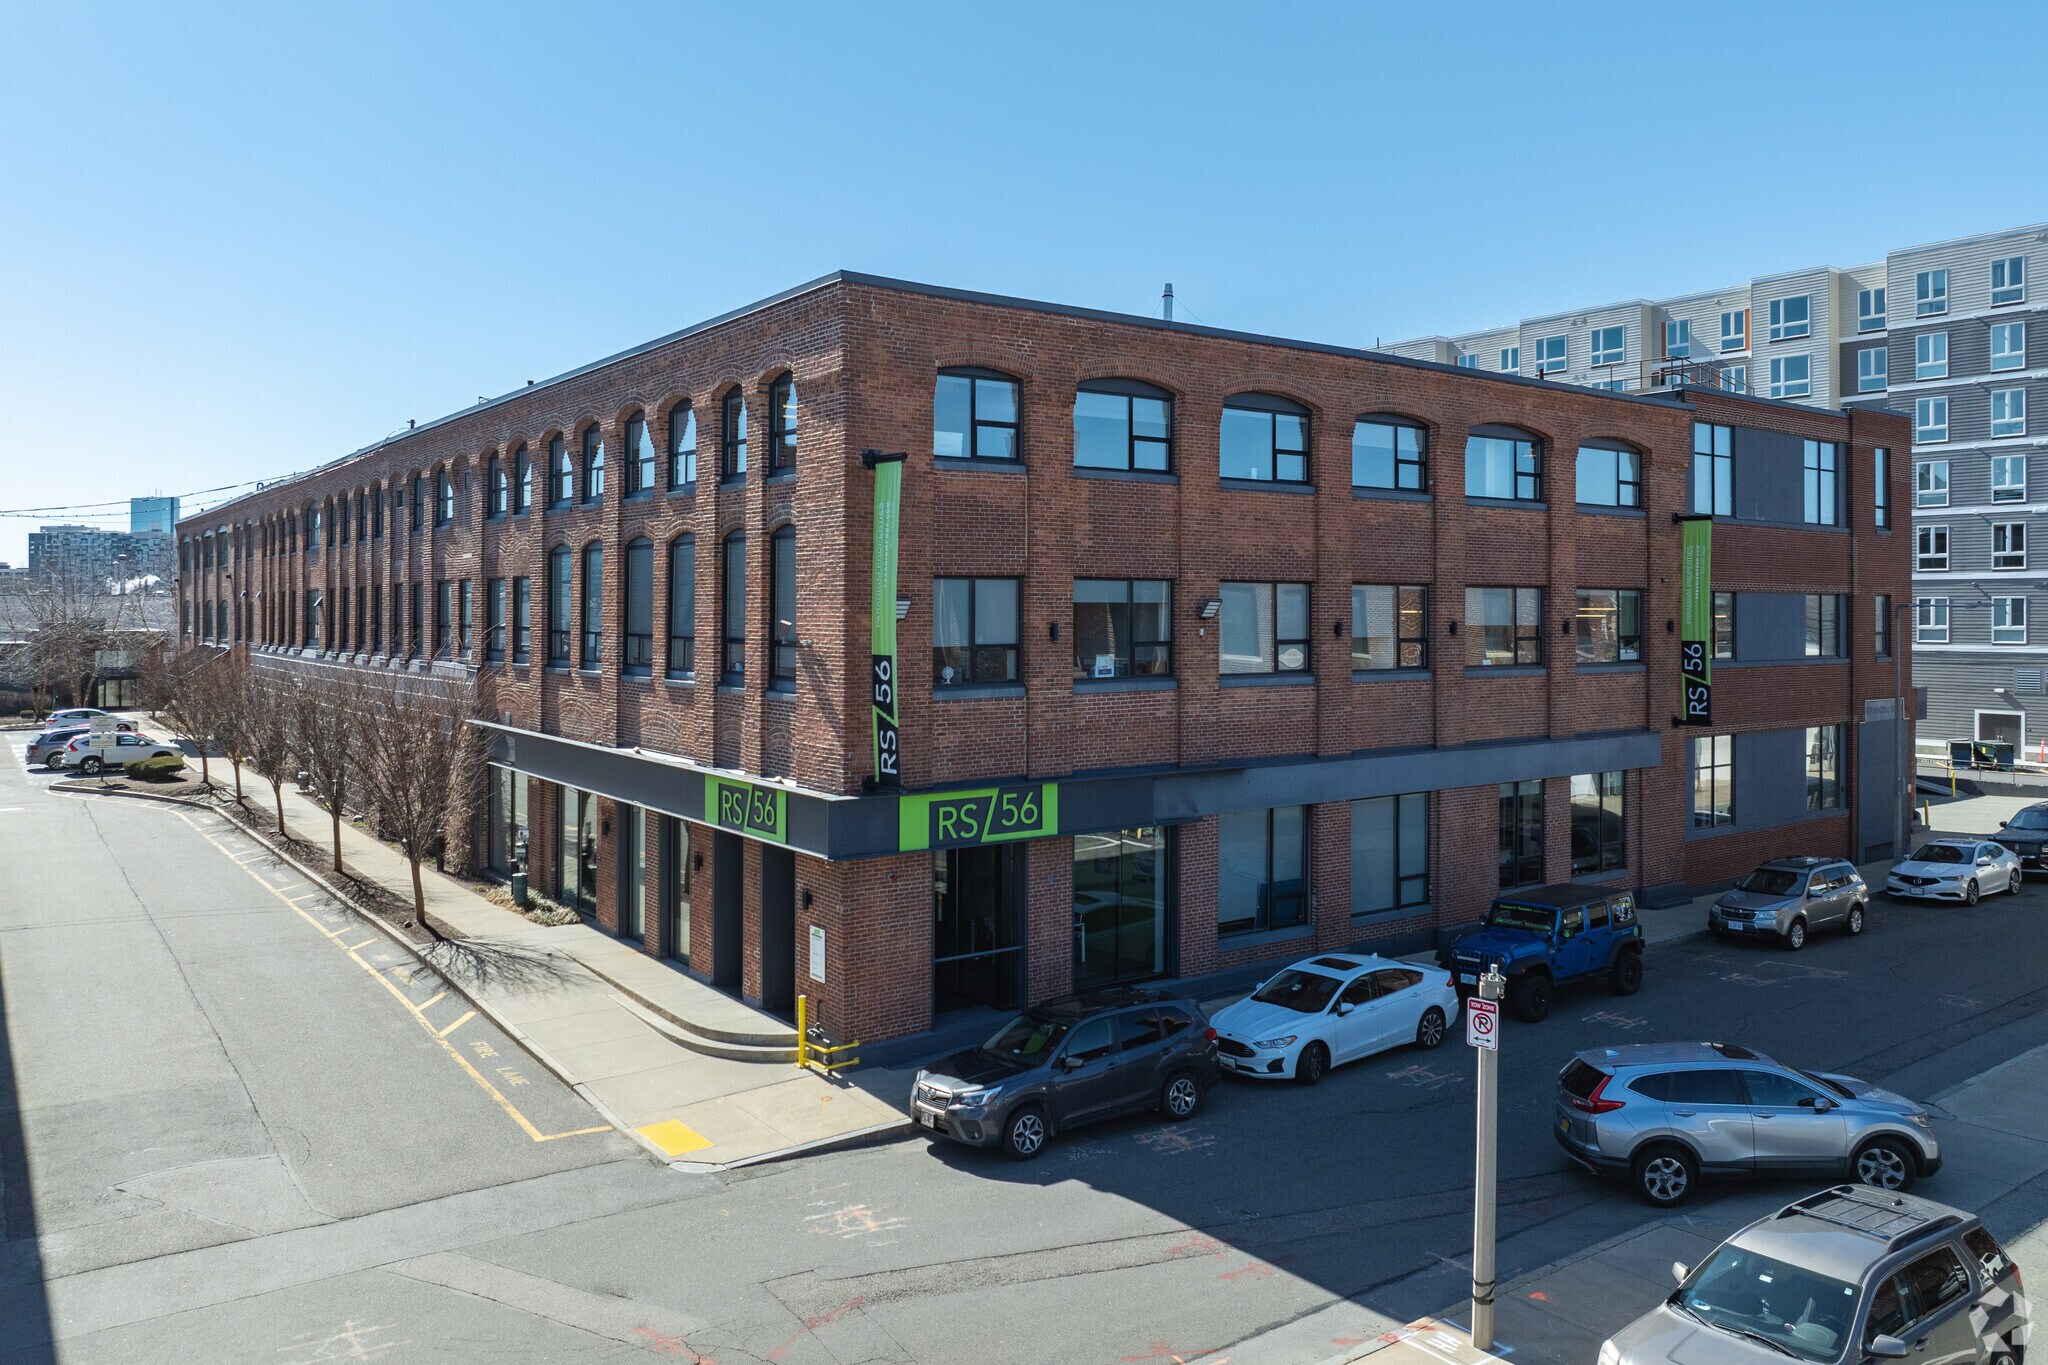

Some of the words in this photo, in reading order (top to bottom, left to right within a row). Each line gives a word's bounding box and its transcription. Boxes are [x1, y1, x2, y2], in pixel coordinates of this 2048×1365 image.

[876, 502, 884, 569] PROPERTIES
[1470, 1001, 1481, 1009] TOW
[1482, 1002, 1495, 1012] ZONE
[468, 1041, 500, 1059] FIRE
[495, 1067, 530, 1086] LANE
